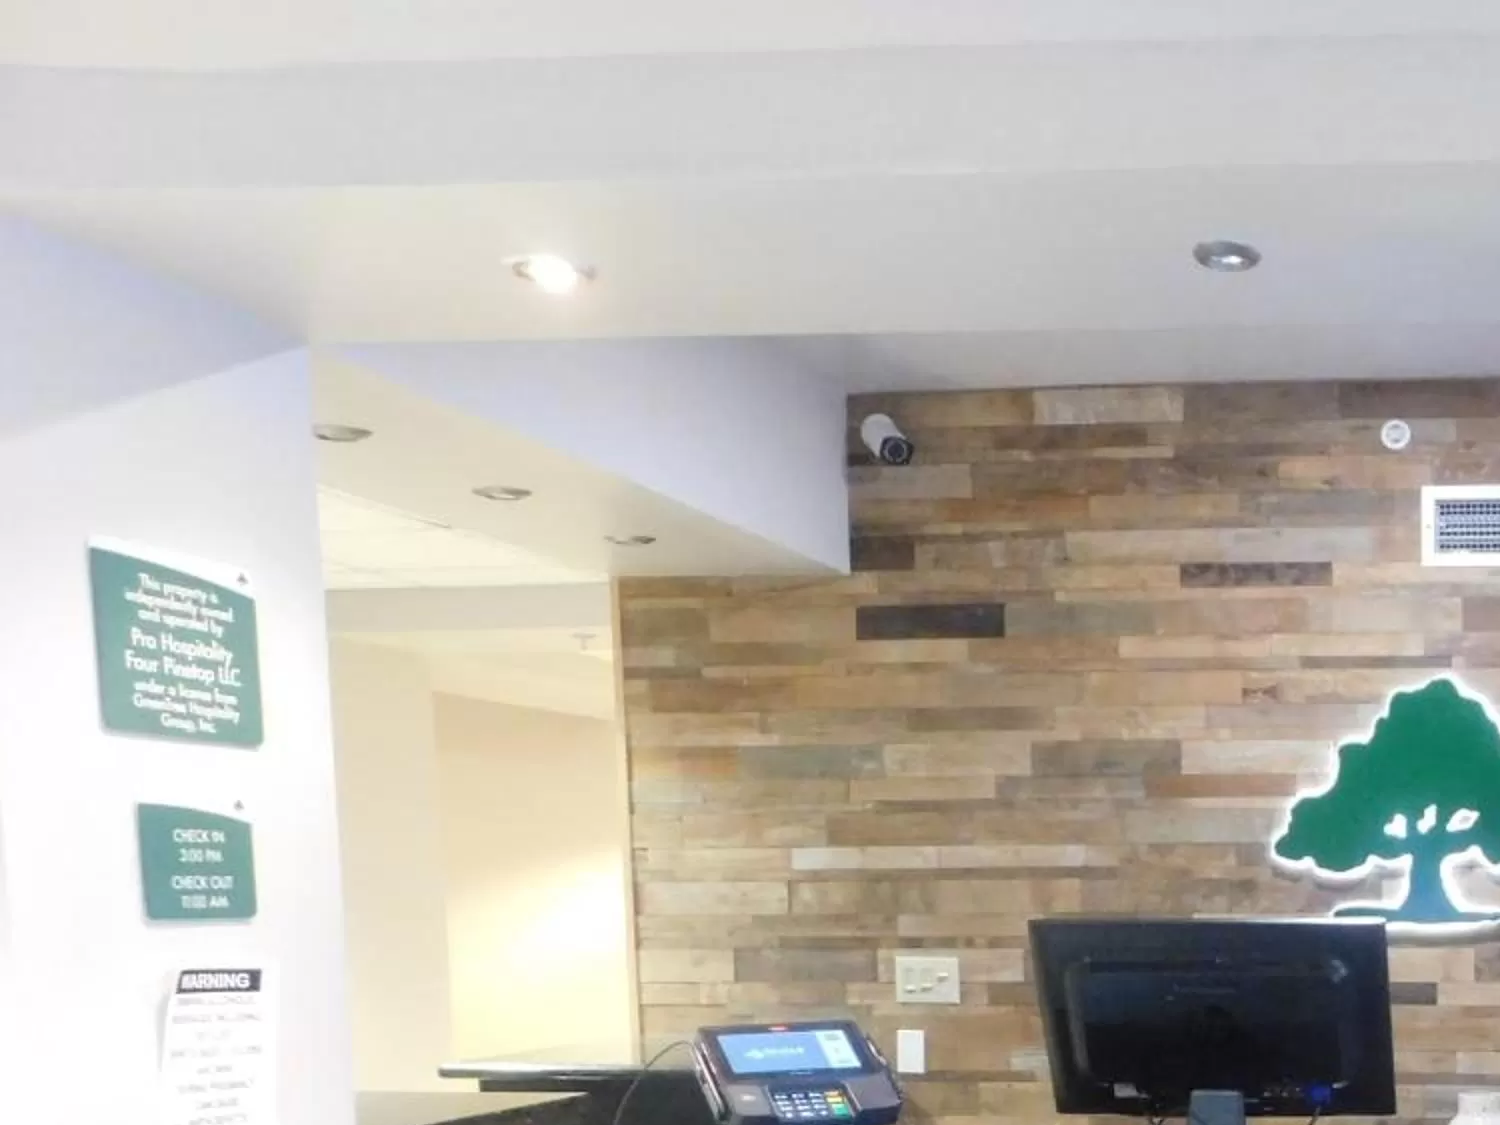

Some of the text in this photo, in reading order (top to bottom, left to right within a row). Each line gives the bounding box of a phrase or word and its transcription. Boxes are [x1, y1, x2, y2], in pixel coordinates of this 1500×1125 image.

[130, 626, 233, 664] Pro Hospitality
[124, 649, 159, 672] Four
[217, 666, 242, 686] LLC
[172, 828, 210, 843] CHECK
[171, 875, 234, 889] CHECK OUT
[209, 895, 230, 908] AM
